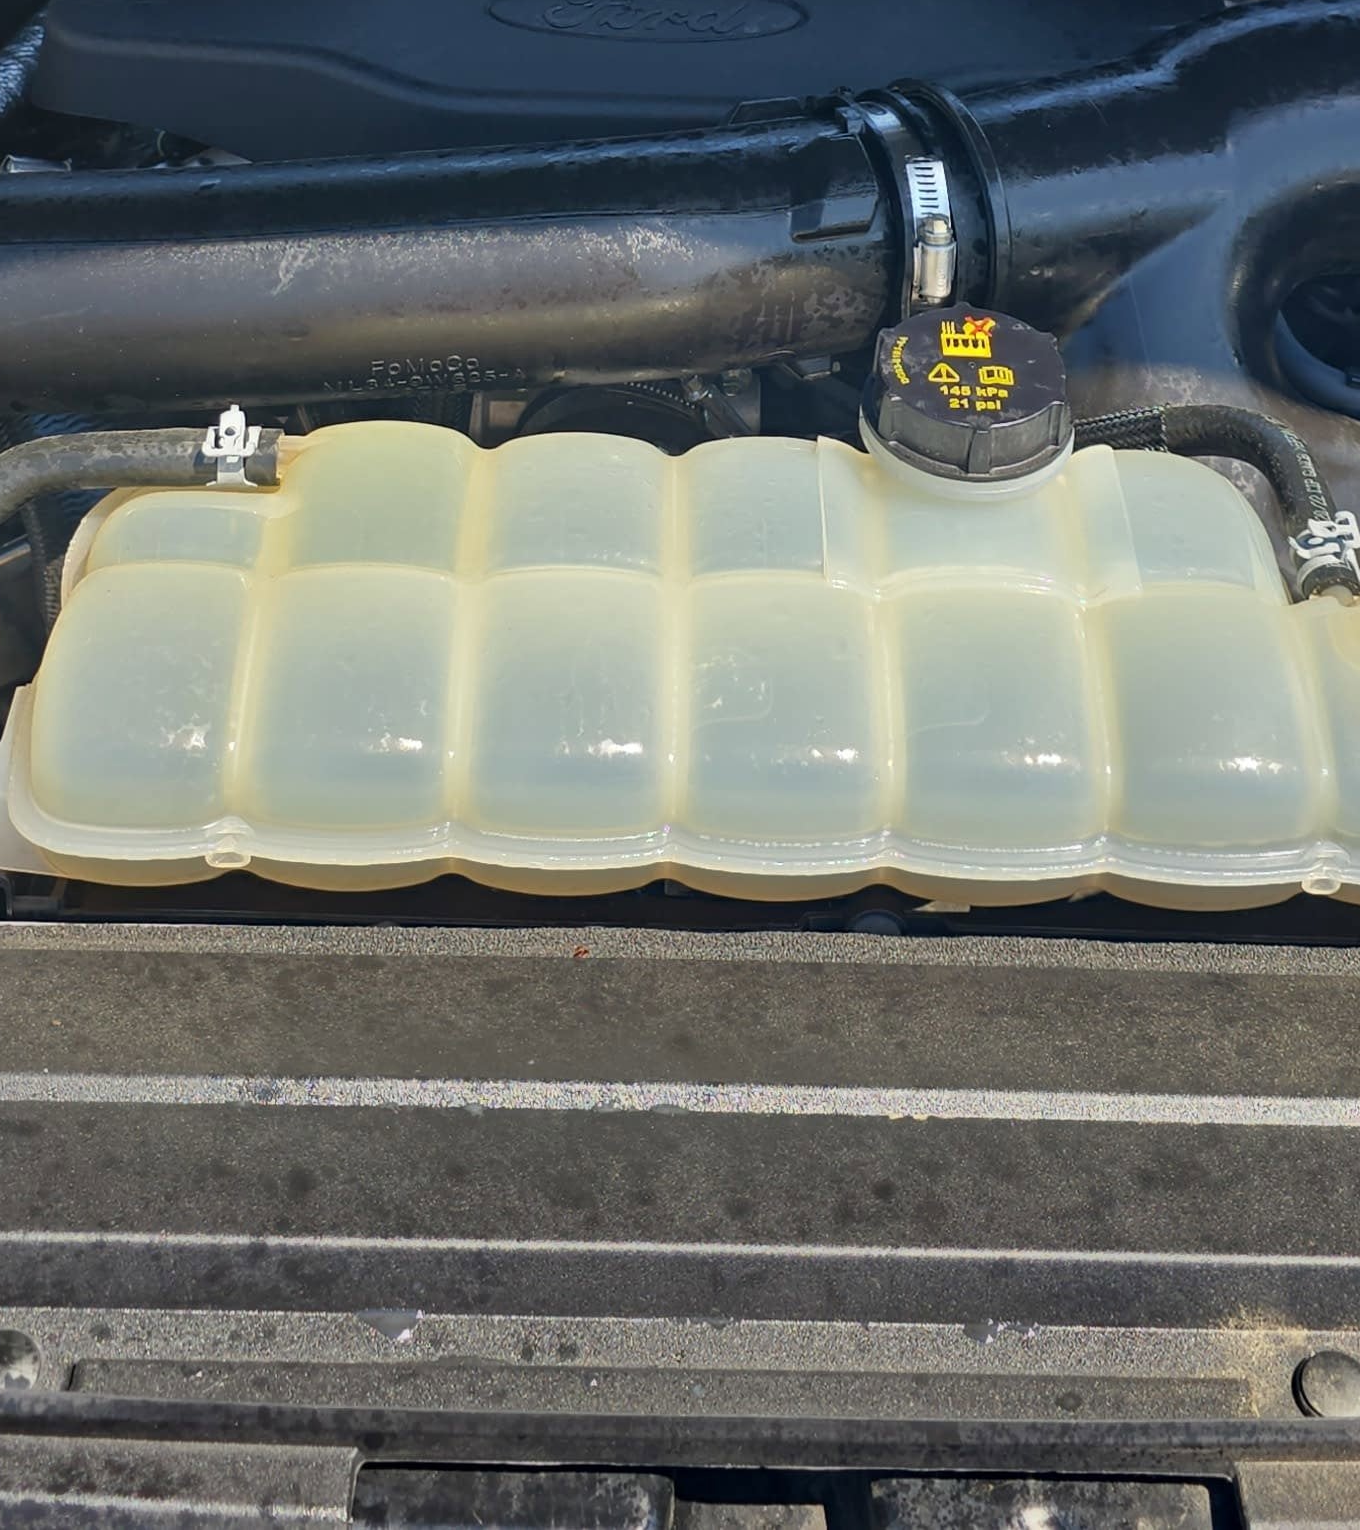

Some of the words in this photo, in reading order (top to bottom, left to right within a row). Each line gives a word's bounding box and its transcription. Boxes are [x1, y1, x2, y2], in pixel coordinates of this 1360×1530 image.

[370, 353, 480, 377] FoMoCo
[940, 384, 971, 397] 145
[976, 385, 1009, 399] kPa
[949, 398, 969, 410] 21
[976, 399, 1001, 412] psi
